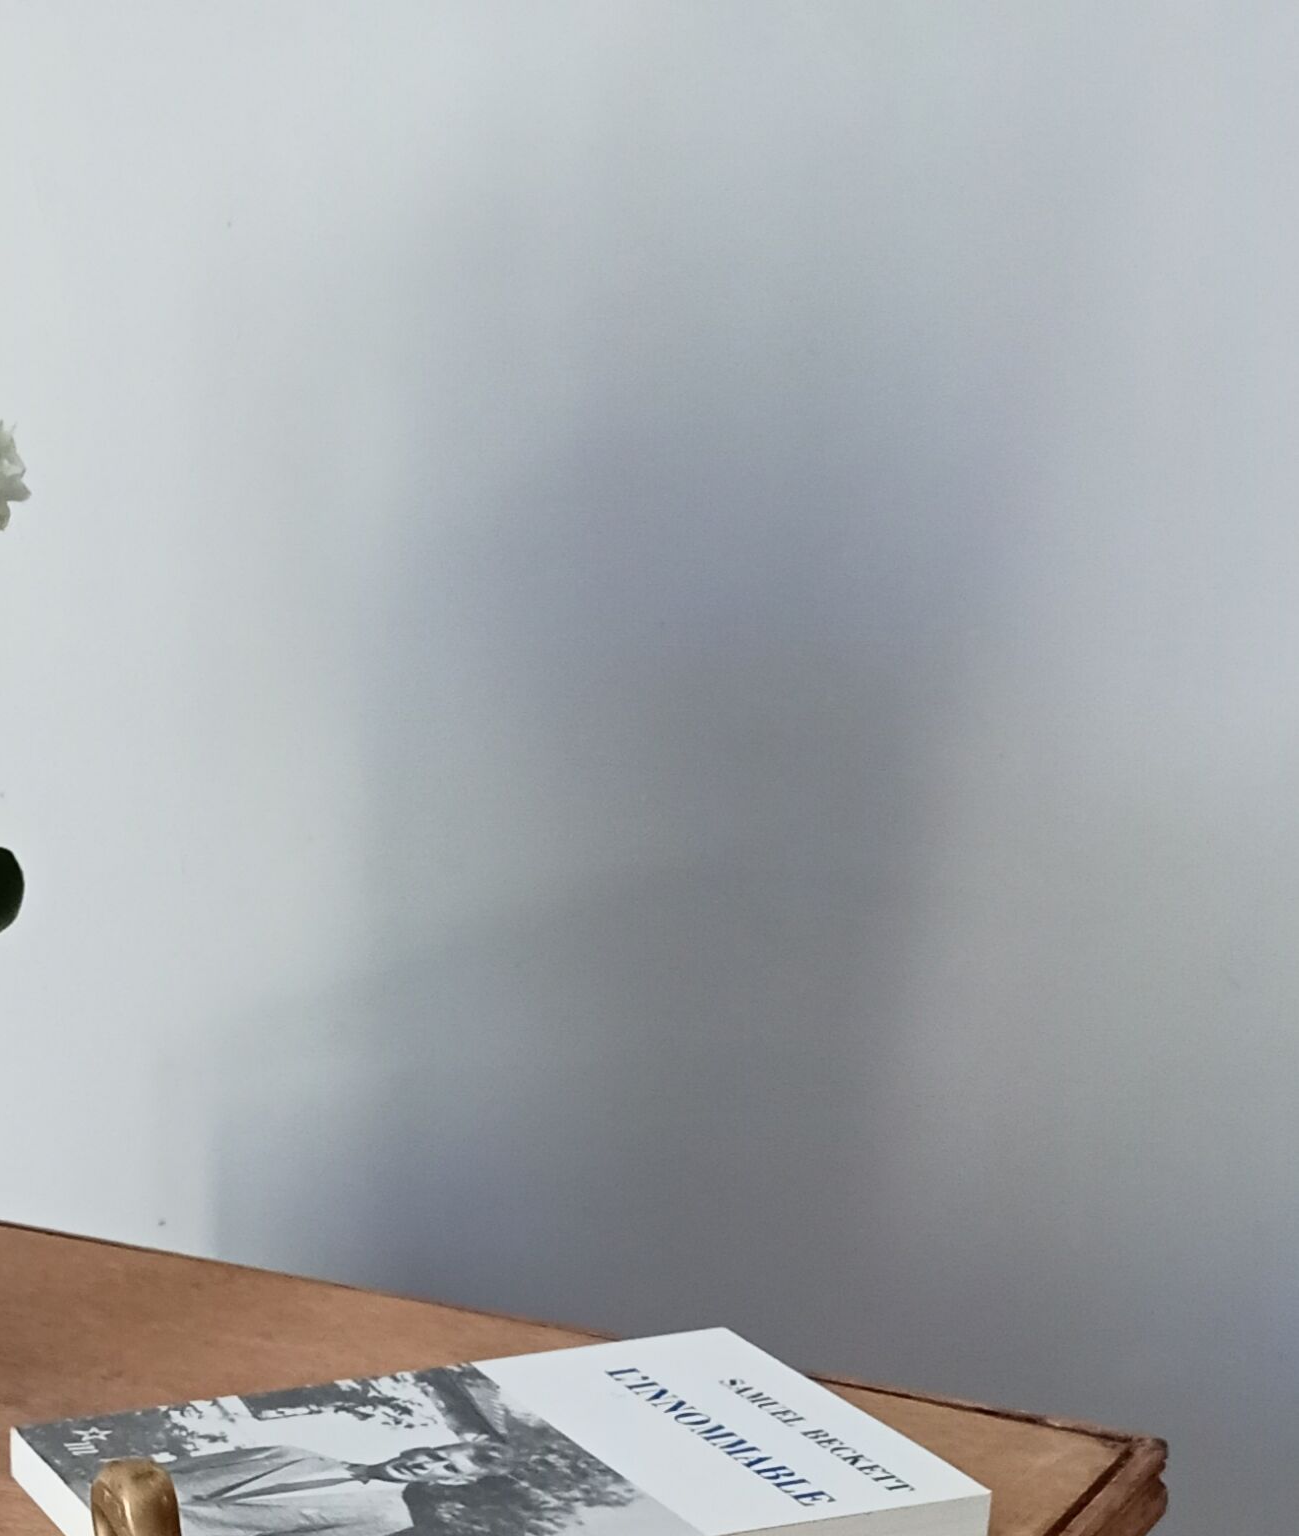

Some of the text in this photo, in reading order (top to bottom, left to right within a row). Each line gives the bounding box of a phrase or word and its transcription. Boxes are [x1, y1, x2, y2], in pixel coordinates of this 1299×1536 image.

[605, 1367, 837, 1507] L'INNOMMABLE
[719, 1377, 916, 1494] SAMUEL BECKETT
